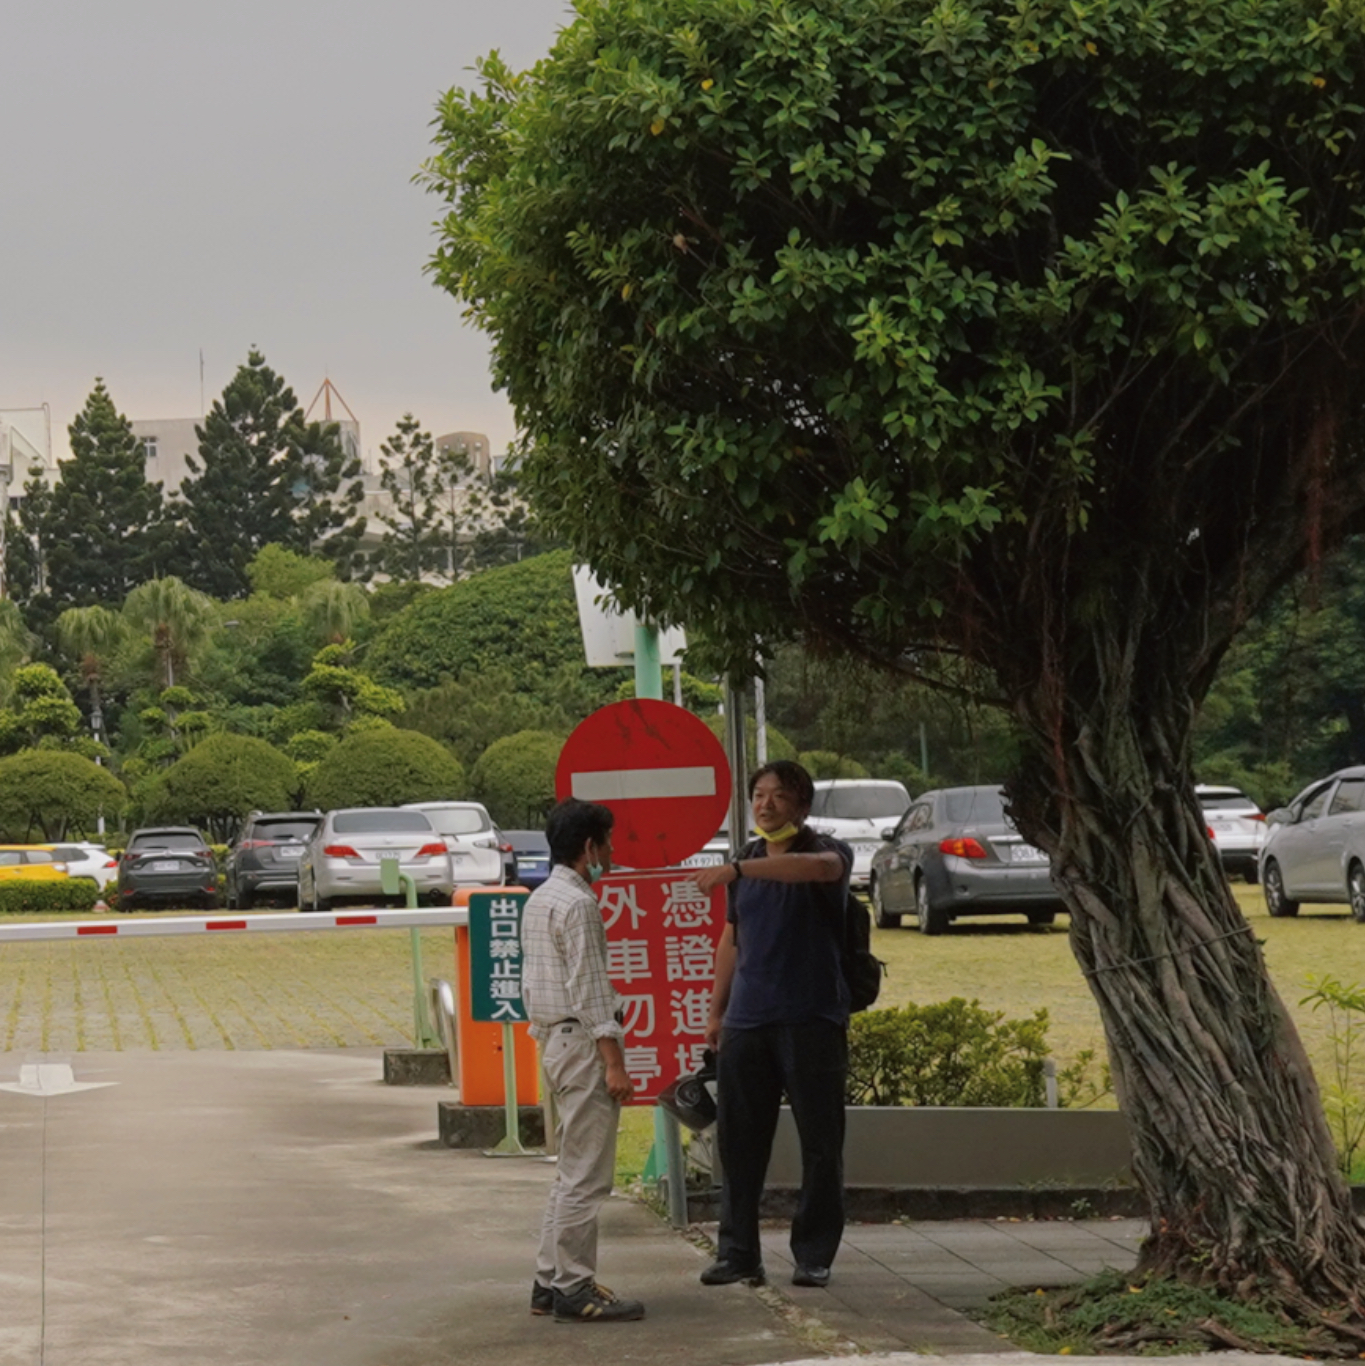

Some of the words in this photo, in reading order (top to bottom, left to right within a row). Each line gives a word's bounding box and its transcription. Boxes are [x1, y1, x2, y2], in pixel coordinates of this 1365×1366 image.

[489, 898, 521, 1019] 出口禁止進入
